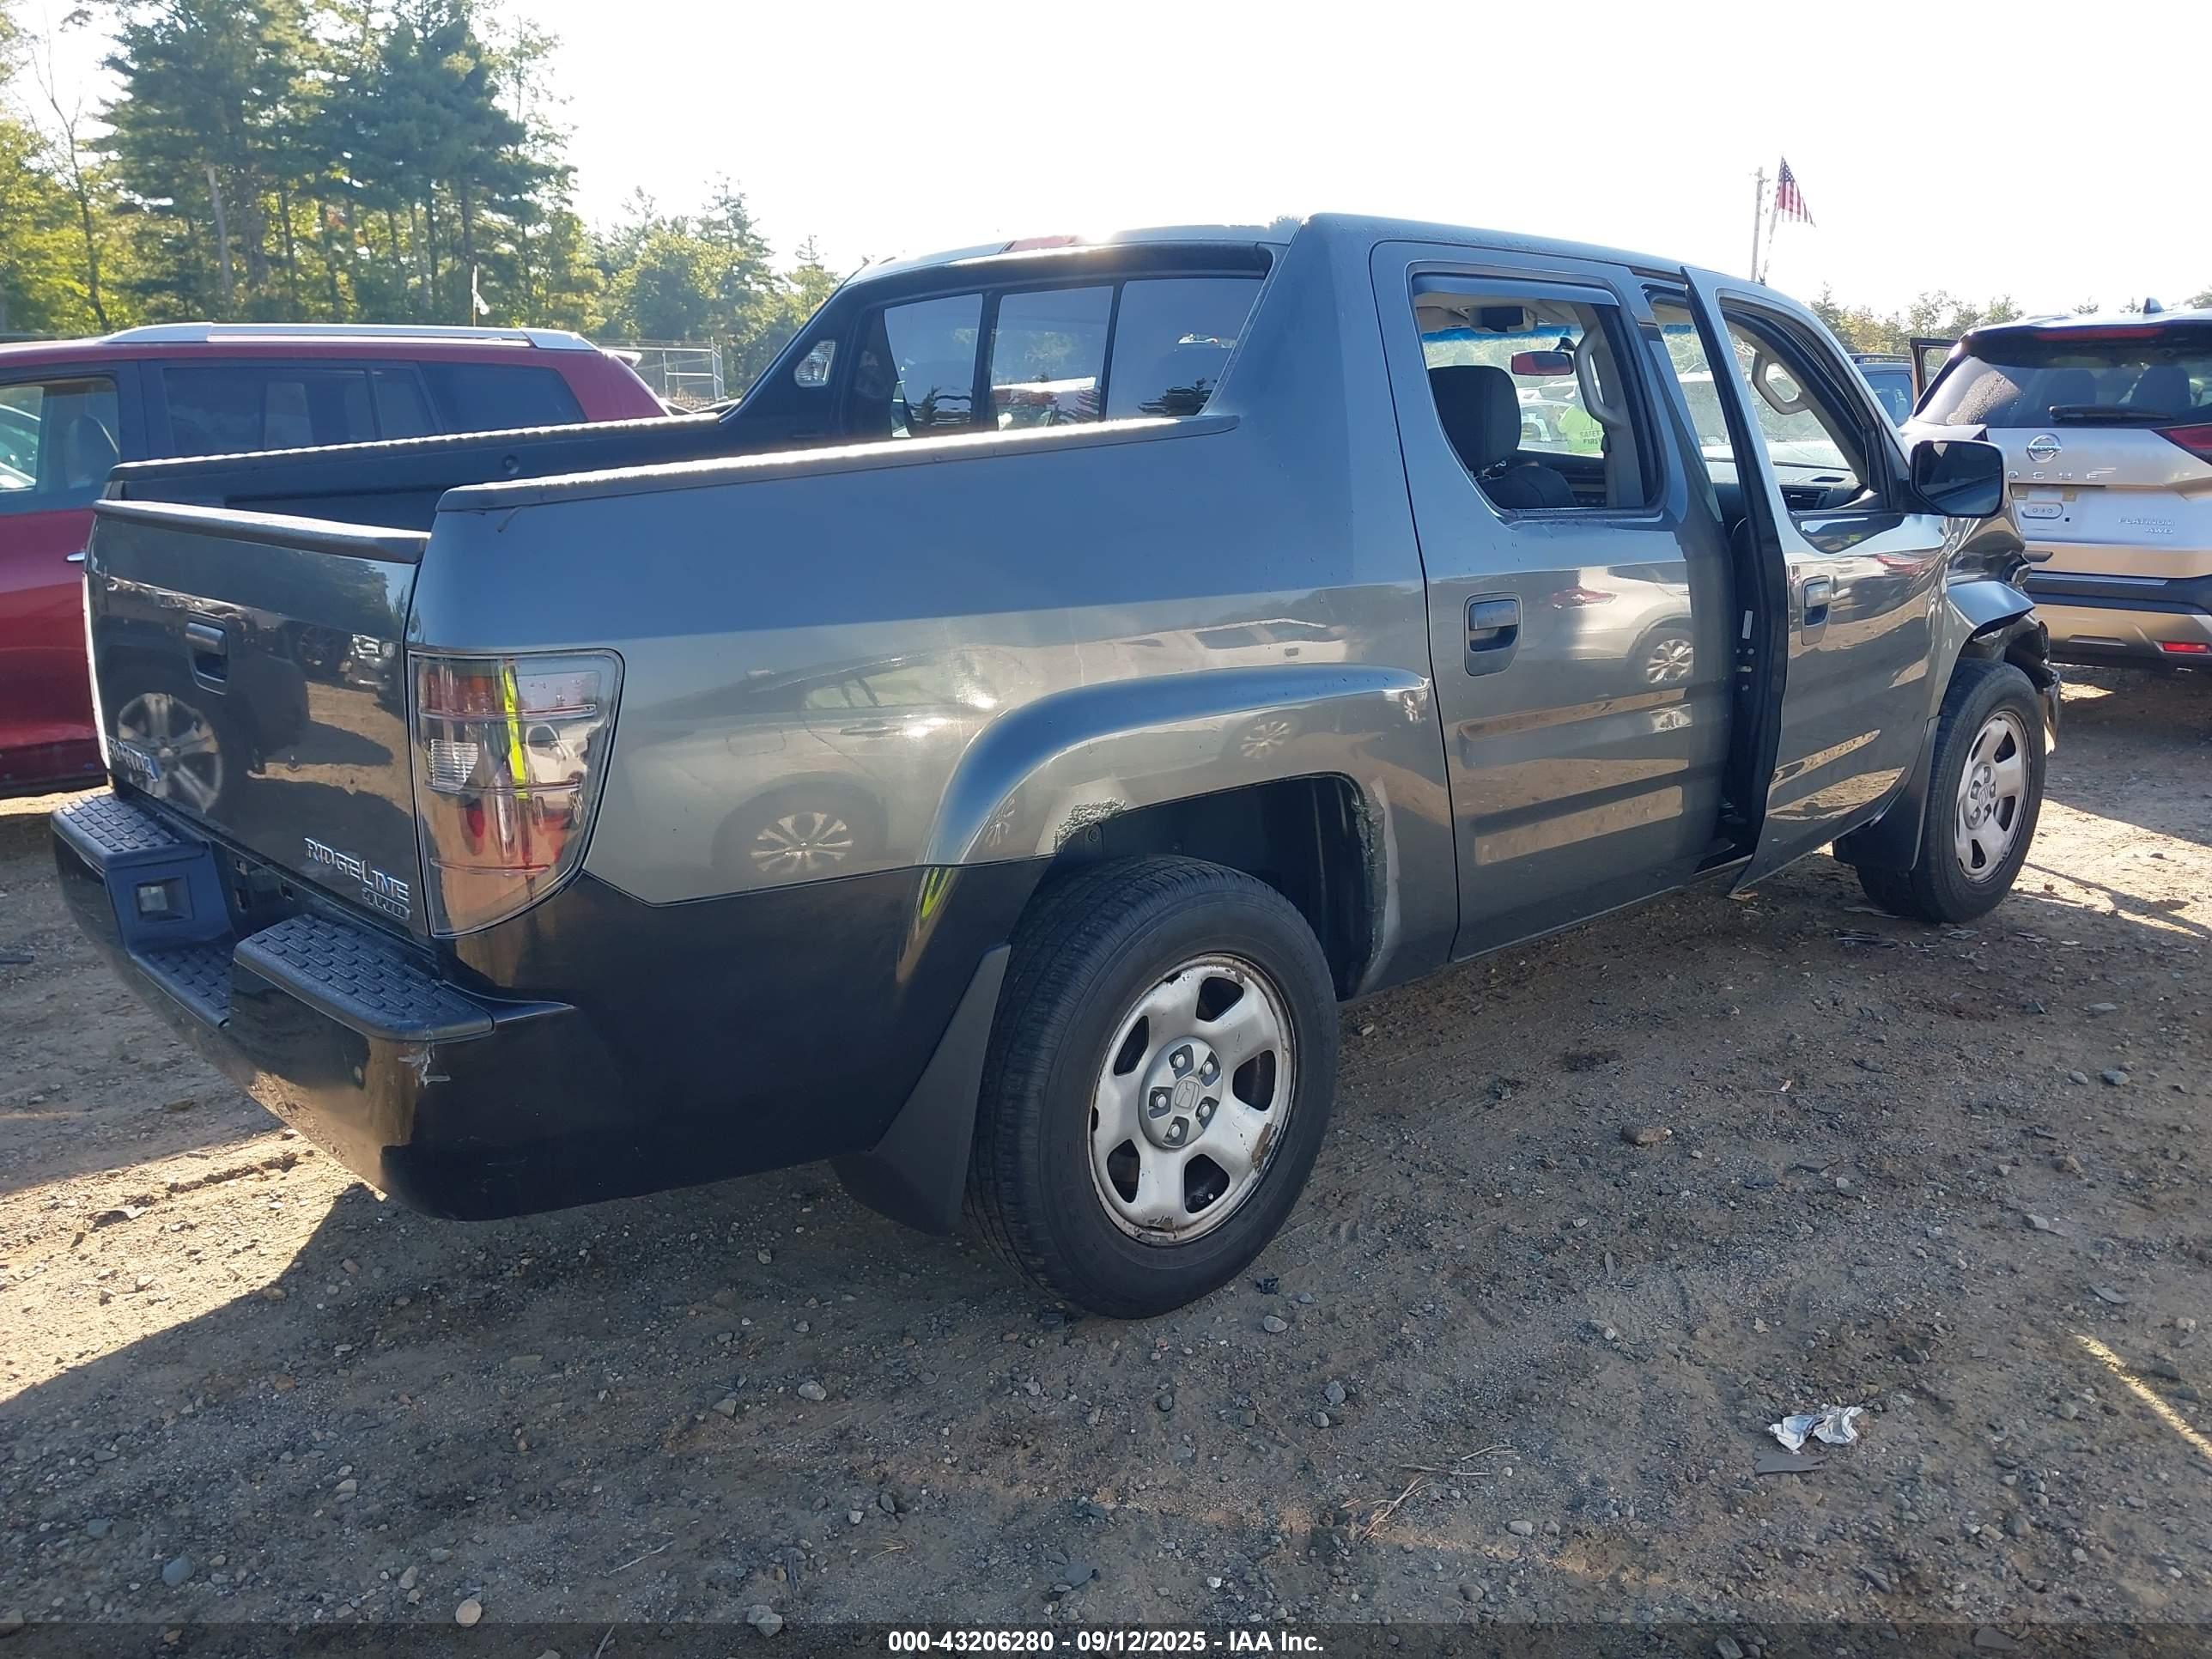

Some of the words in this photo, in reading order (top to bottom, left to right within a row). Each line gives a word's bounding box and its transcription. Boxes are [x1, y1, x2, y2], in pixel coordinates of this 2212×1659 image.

[2007, 470, 2099, 481] OGUE
[2118, 517, 2174, 526] PLATINUM
[2144, 526, 2174, 535] AWD
[304, 837, 410, 902] RIDGELINE
